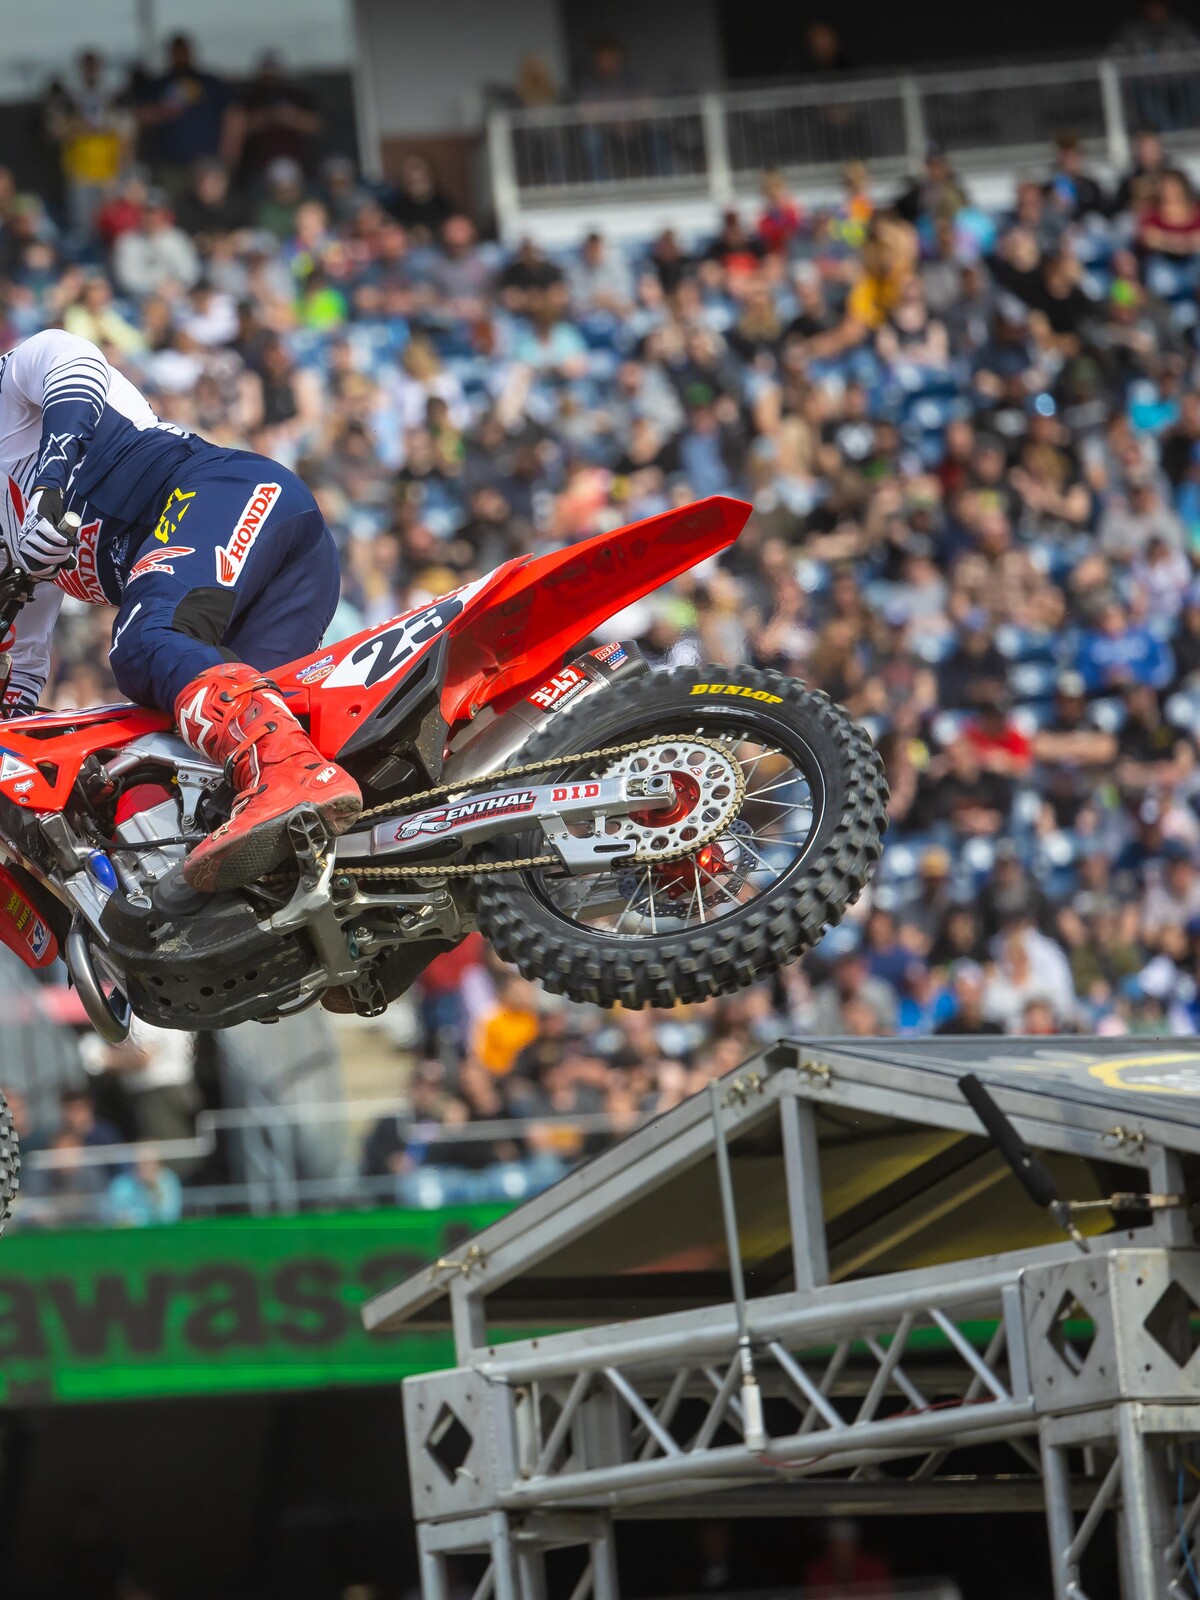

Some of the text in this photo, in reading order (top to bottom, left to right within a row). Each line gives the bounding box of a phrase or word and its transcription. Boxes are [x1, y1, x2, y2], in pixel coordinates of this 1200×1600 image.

[230, 486, 278, 563] HONDA
[80, 521, 111, 605] ONDA
[351, 595, 464, 689] 23
[550, 679, 589, 712] YOSHIMURA
[689, 683, 784, 704] DUNLOP
[399, 793, 535, 838] RENTHAL
[454, 803, 531, 825] CHAINWHEELS
